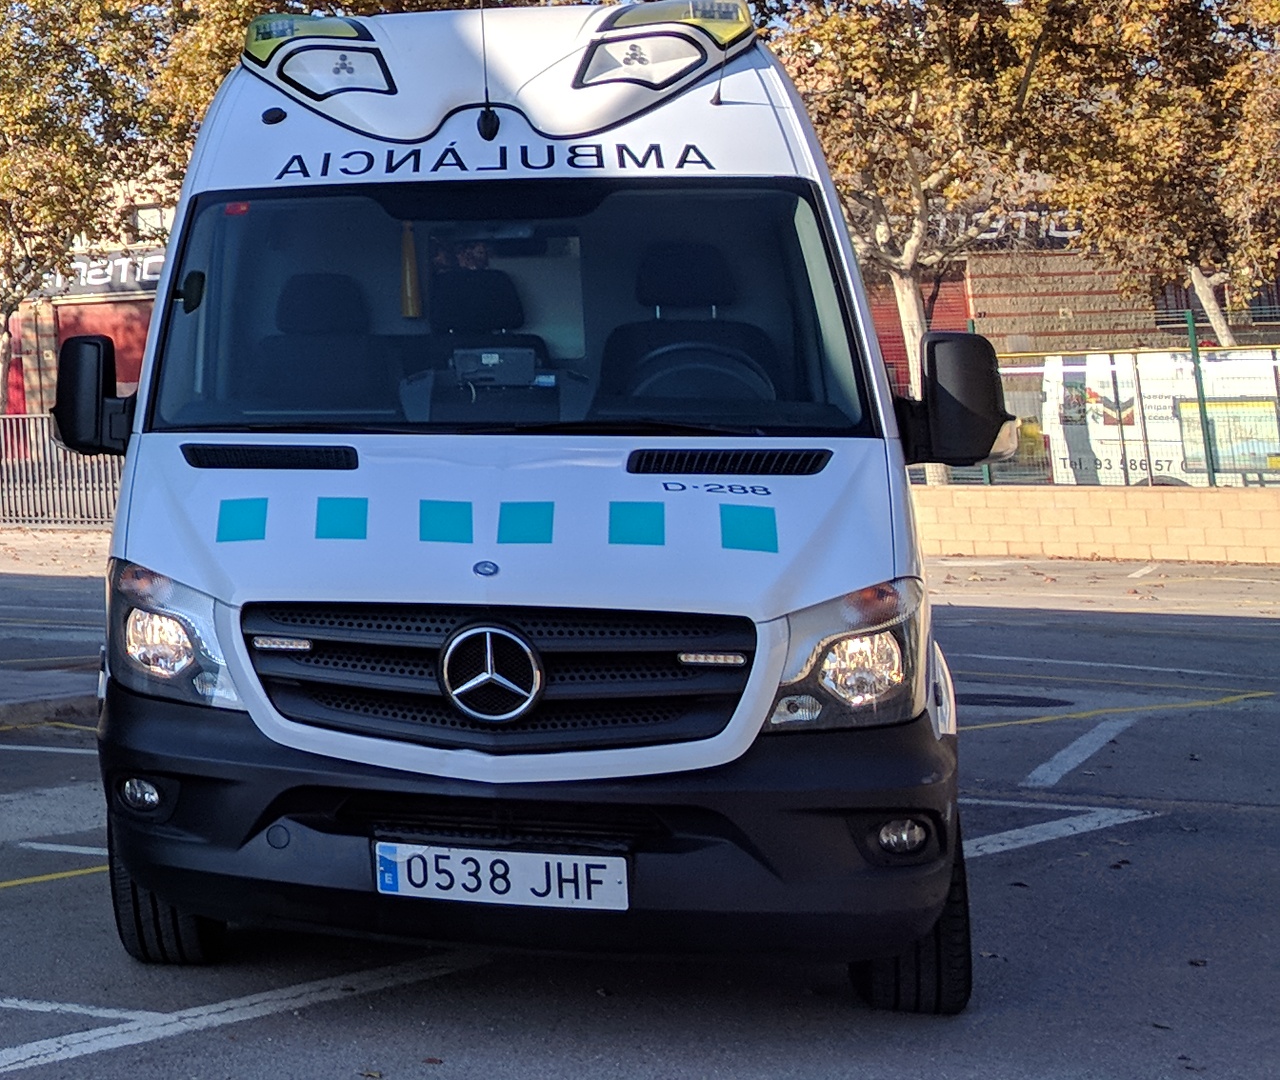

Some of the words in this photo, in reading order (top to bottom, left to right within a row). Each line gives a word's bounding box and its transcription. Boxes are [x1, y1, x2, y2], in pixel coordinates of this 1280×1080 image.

[1059, 456, 1088, 470] Tel.
[1093, 458, 1113, 470] 93
[1154, 460, 1174, 471] 57
[384, 872, 394, 885] E
[406, 853, 512, 896] 0538
[529, 861, 608, 901] JHF
